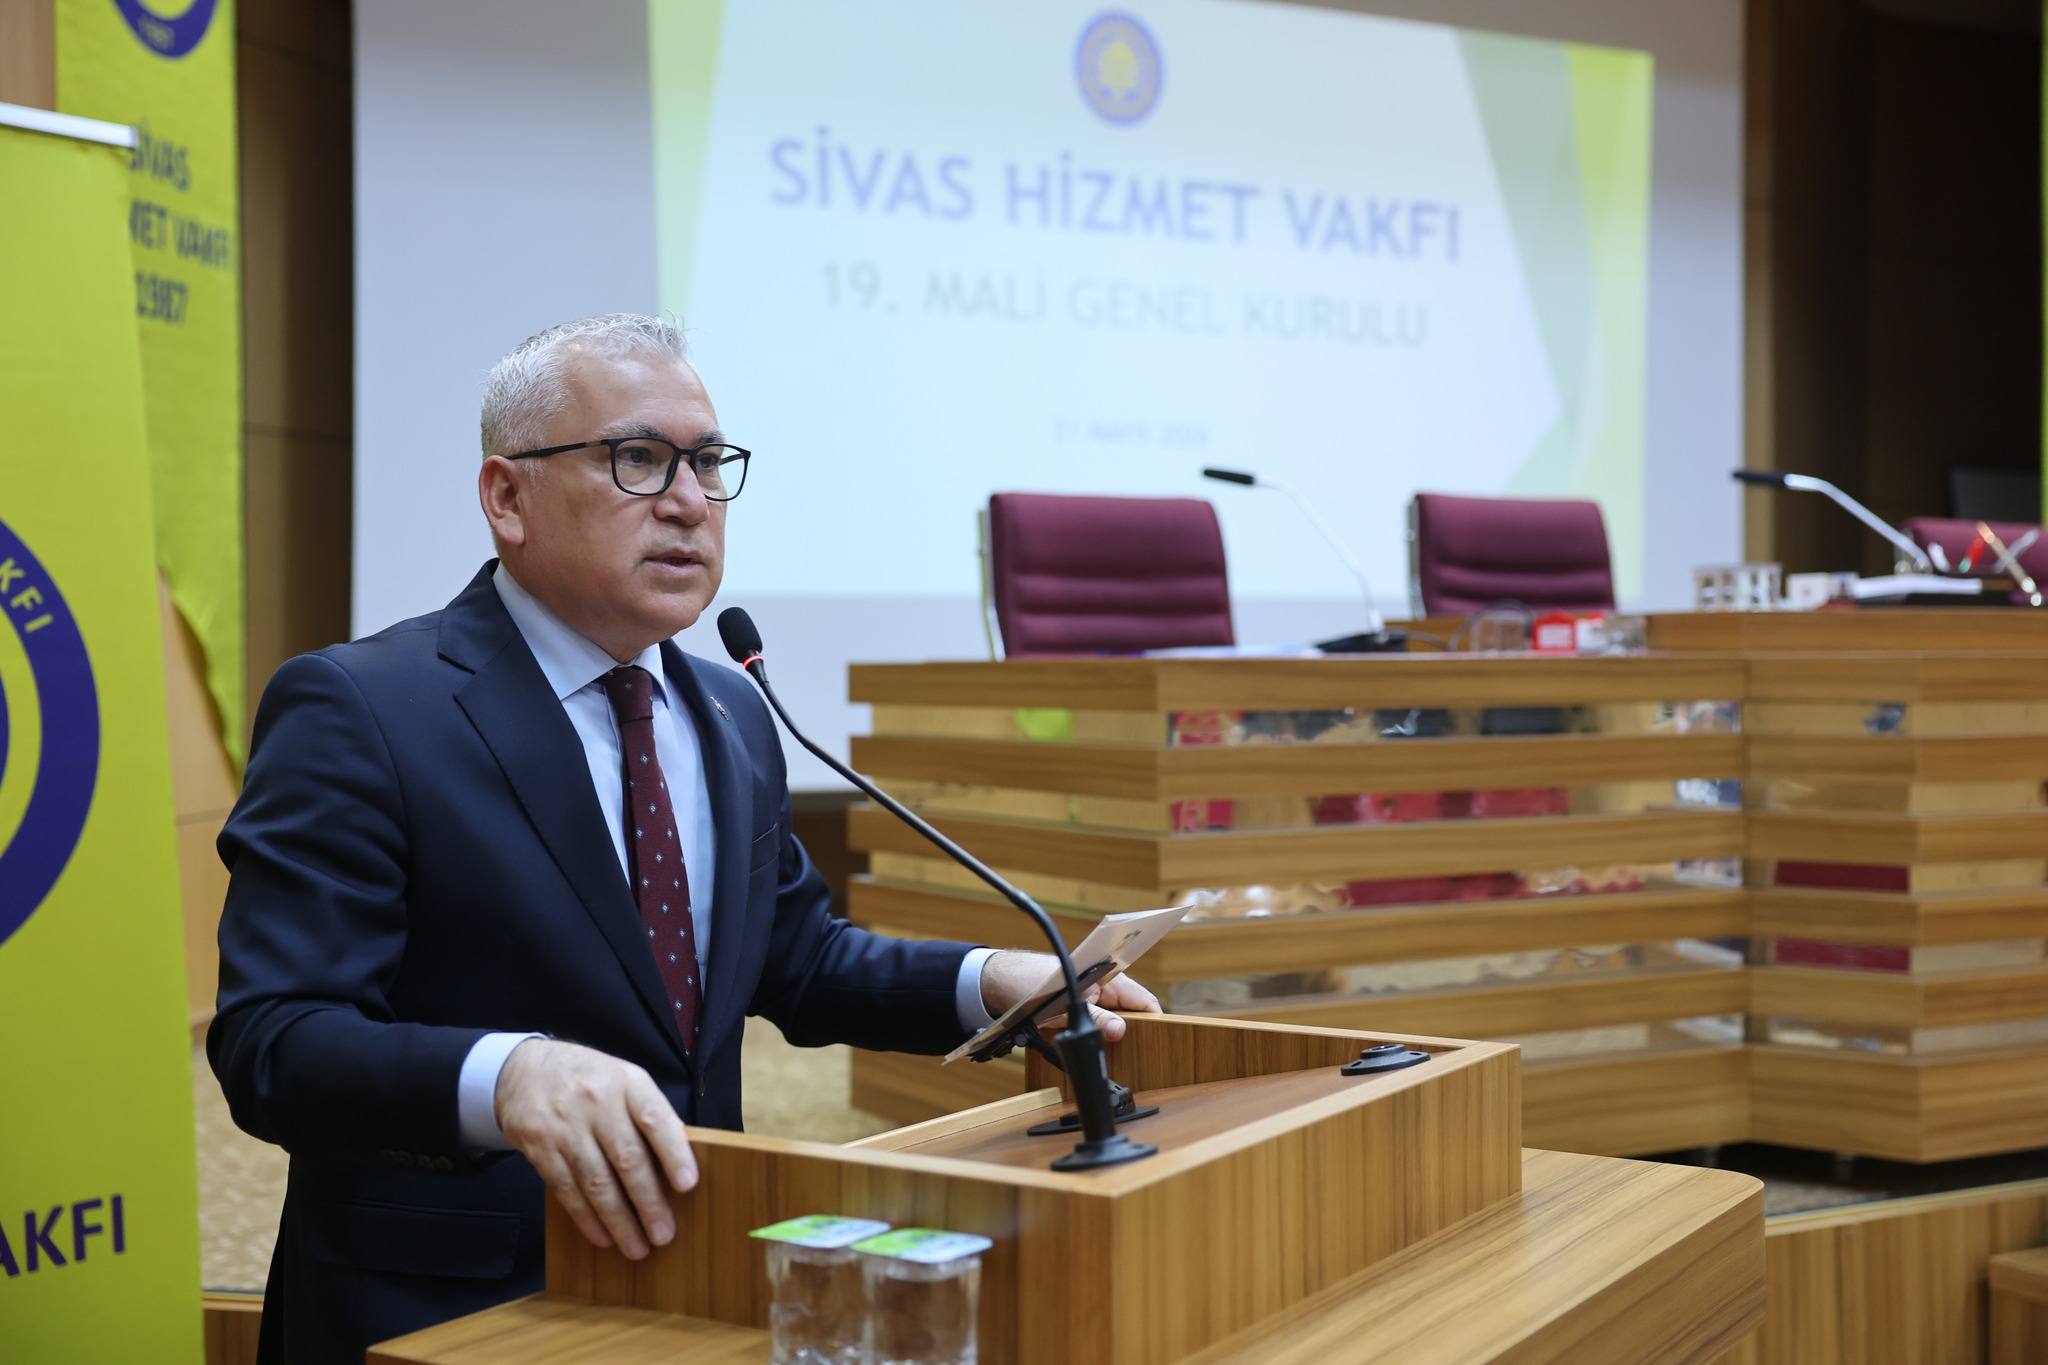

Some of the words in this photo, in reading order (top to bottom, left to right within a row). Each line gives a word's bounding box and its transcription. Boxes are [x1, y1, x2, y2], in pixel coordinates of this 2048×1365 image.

[769, 124, 976, 223] SİVAS
[1005, 149, 1262, 247] HİZMET
[1280, 187, 1462, 263] VAKFI
[819, 258, 902, 316] 19.
